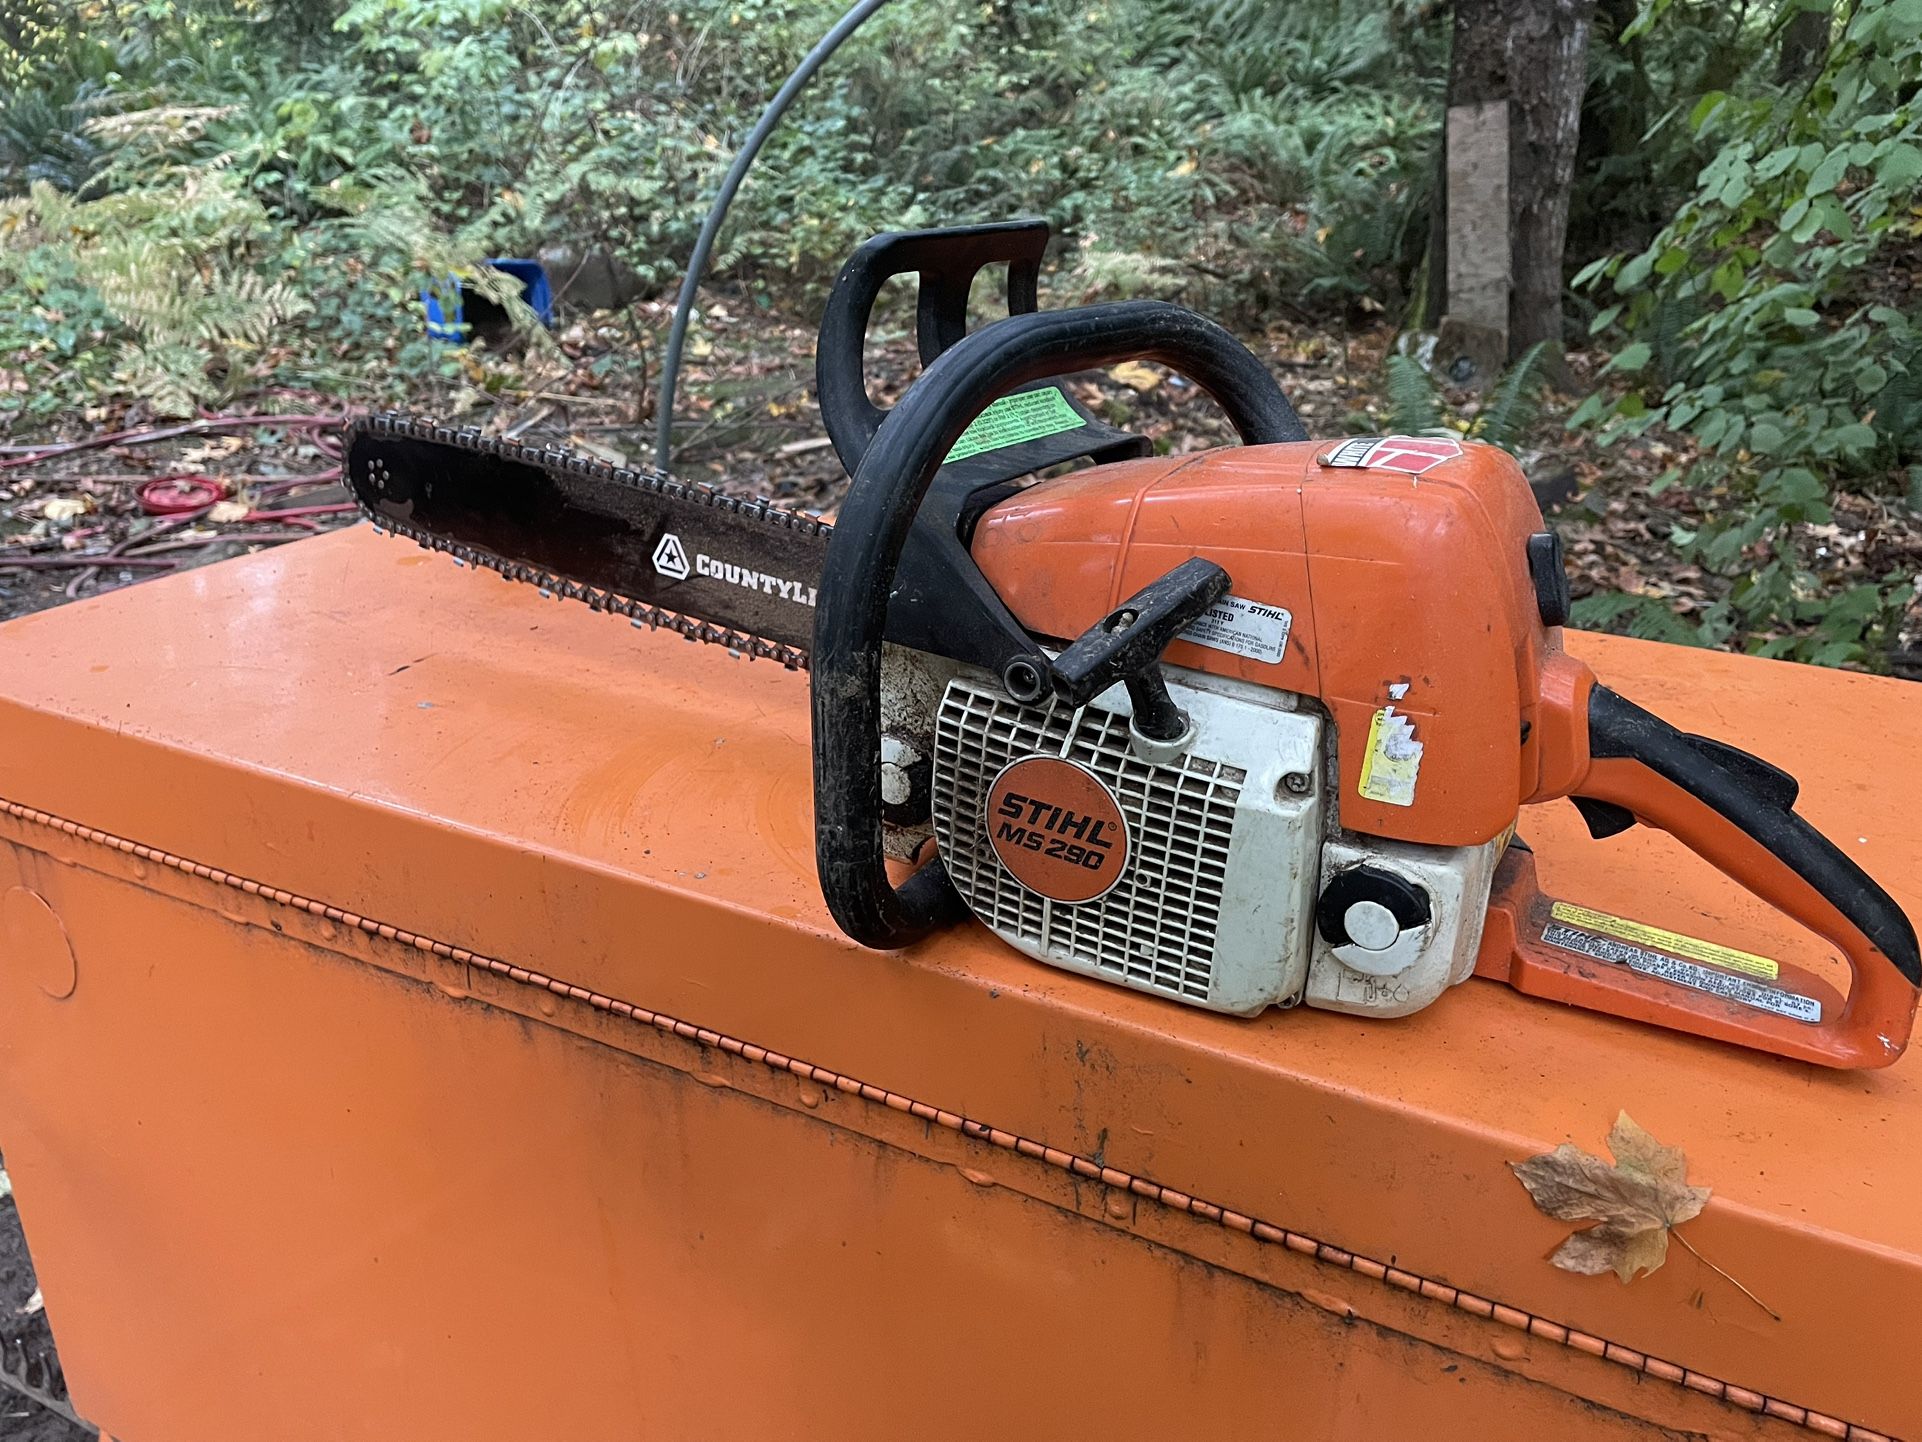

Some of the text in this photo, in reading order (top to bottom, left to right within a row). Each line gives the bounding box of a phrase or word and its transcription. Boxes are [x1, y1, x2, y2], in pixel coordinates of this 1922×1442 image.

[696, 554, 817, 607] COUNTYLI
[1205, 609, 1234, 622] LISTED
[1230, 601, 1246, 610] SAW
[1248, 606, 1283, 621] STIHL
[998, 792, 1113, 849] STIHL
[997, 822, 1105, 870] MS 290
